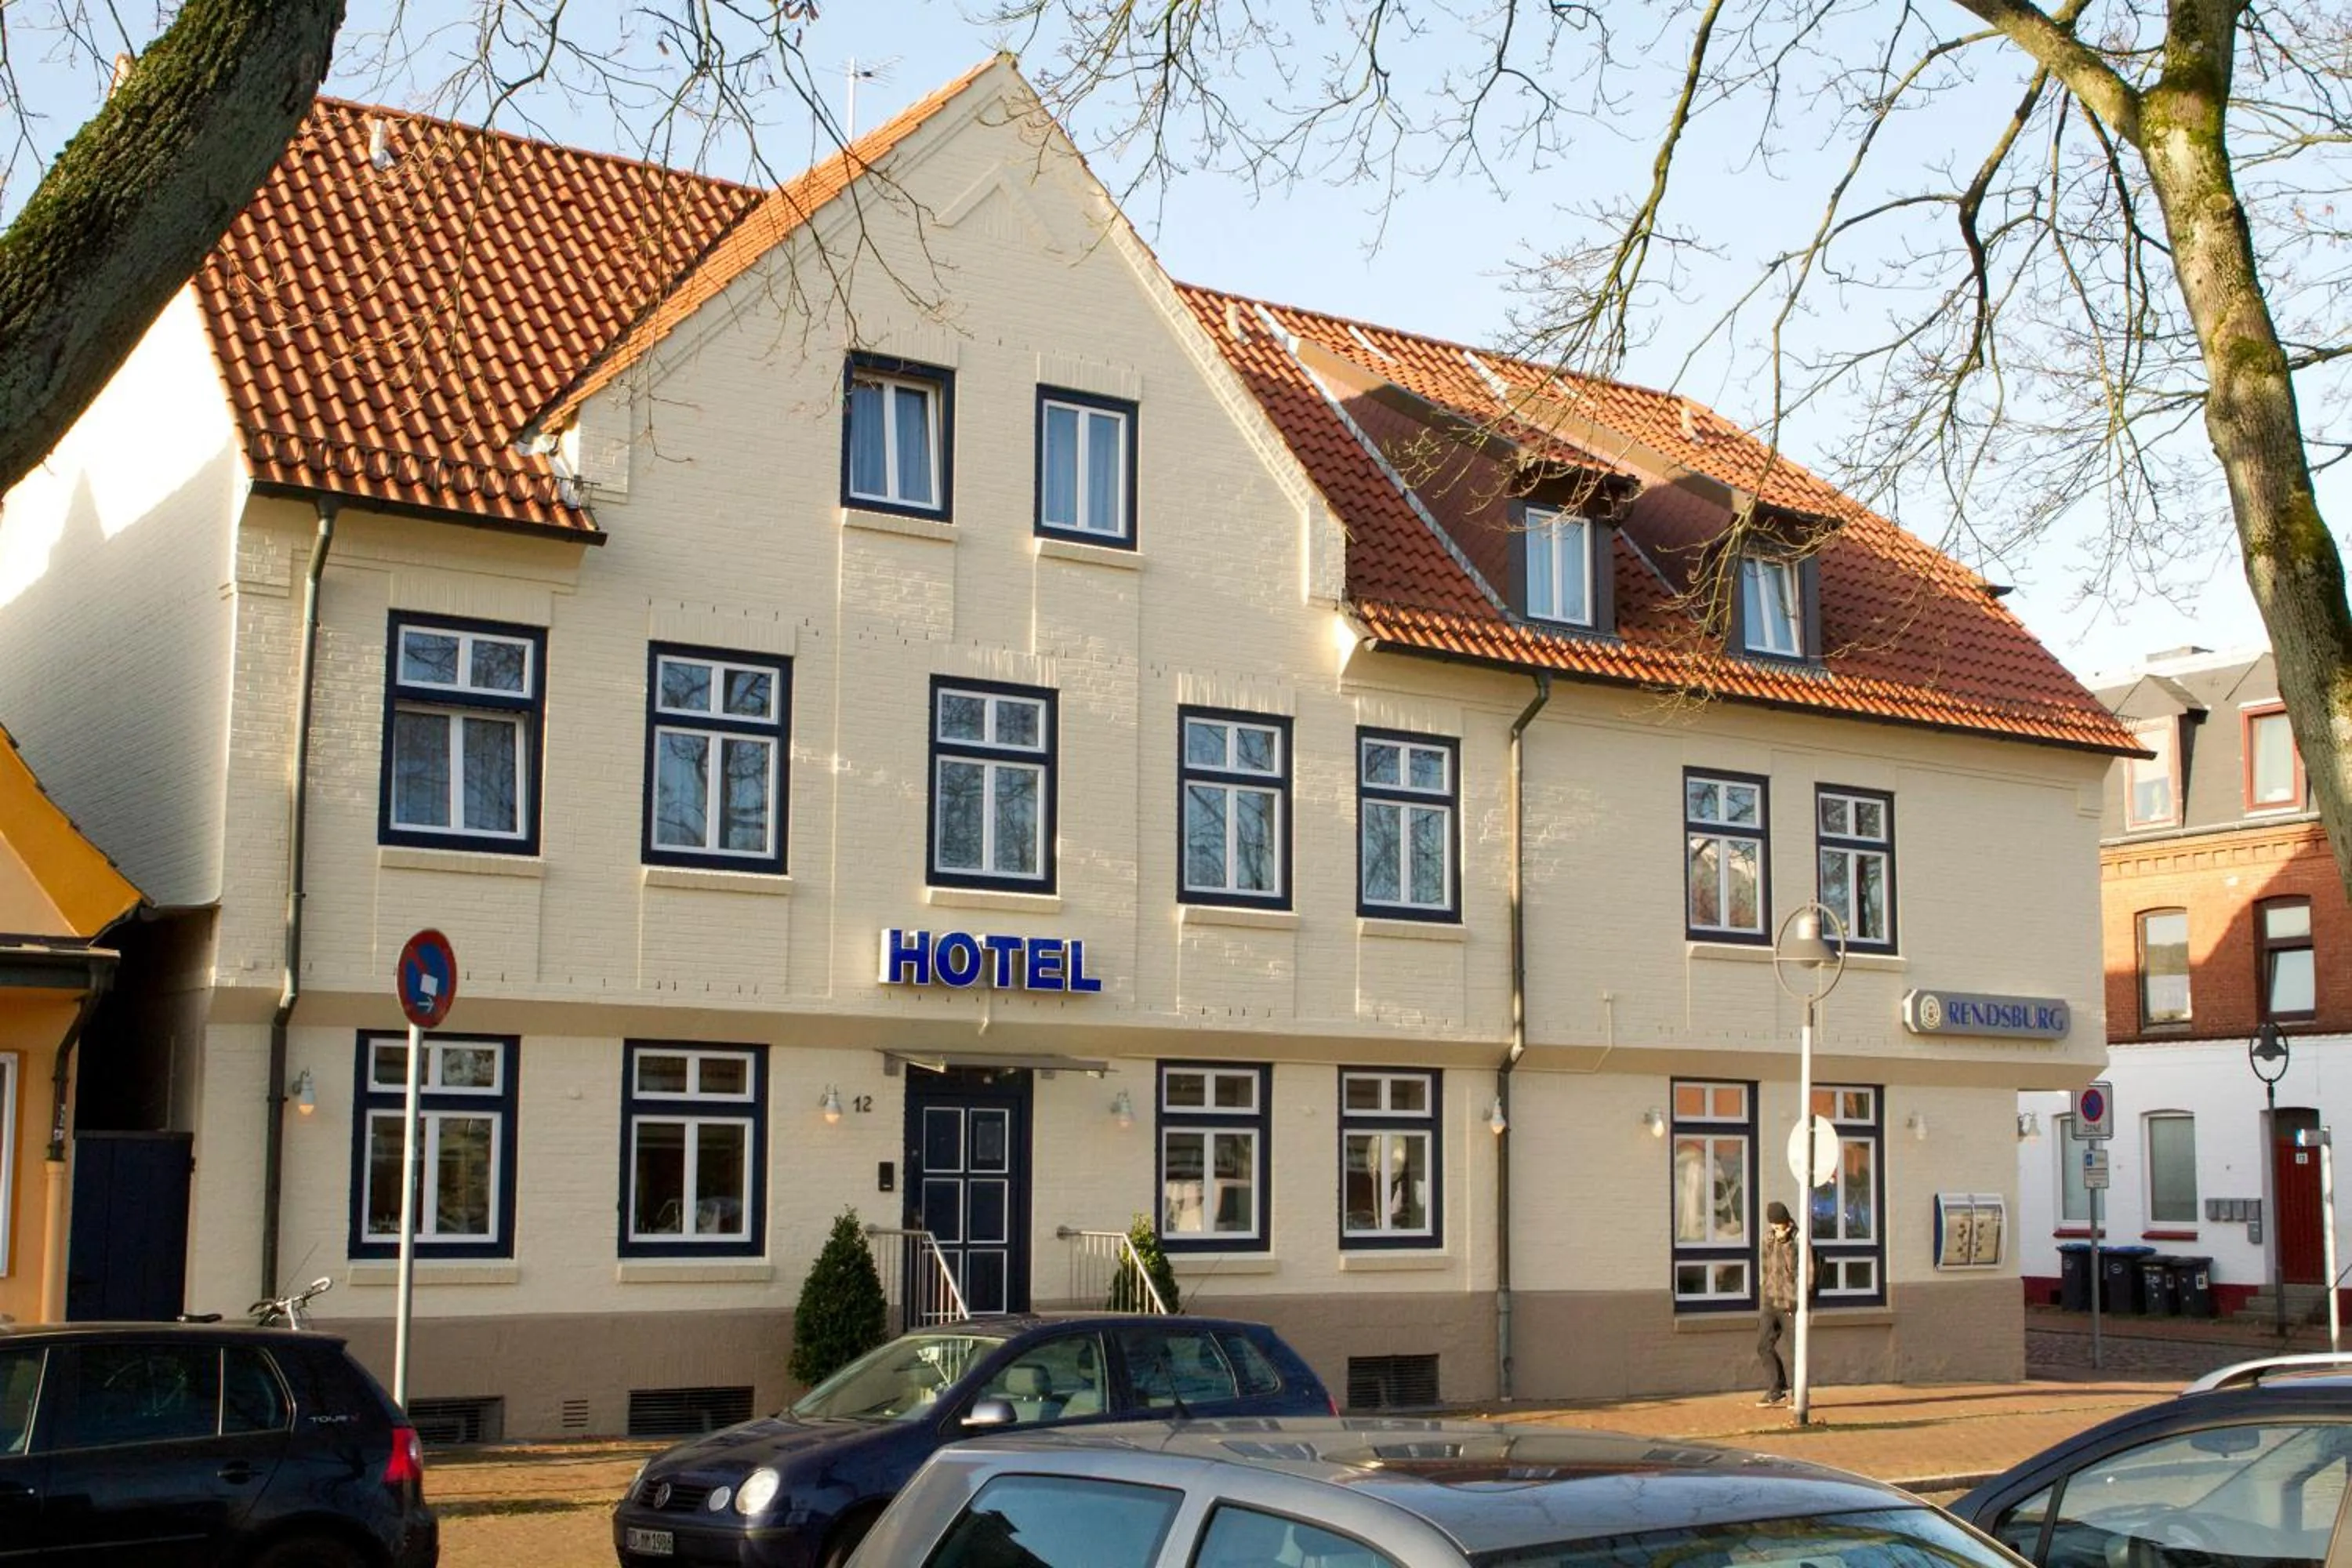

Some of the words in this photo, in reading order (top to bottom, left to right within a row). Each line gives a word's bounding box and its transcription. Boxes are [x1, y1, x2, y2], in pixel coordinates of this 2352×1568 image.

[879, 928, 1102, 993] HOTEL
[1948, 1000, 2065, 1032] RENDSBURG
[853, 1095, 872, 1112] 12
